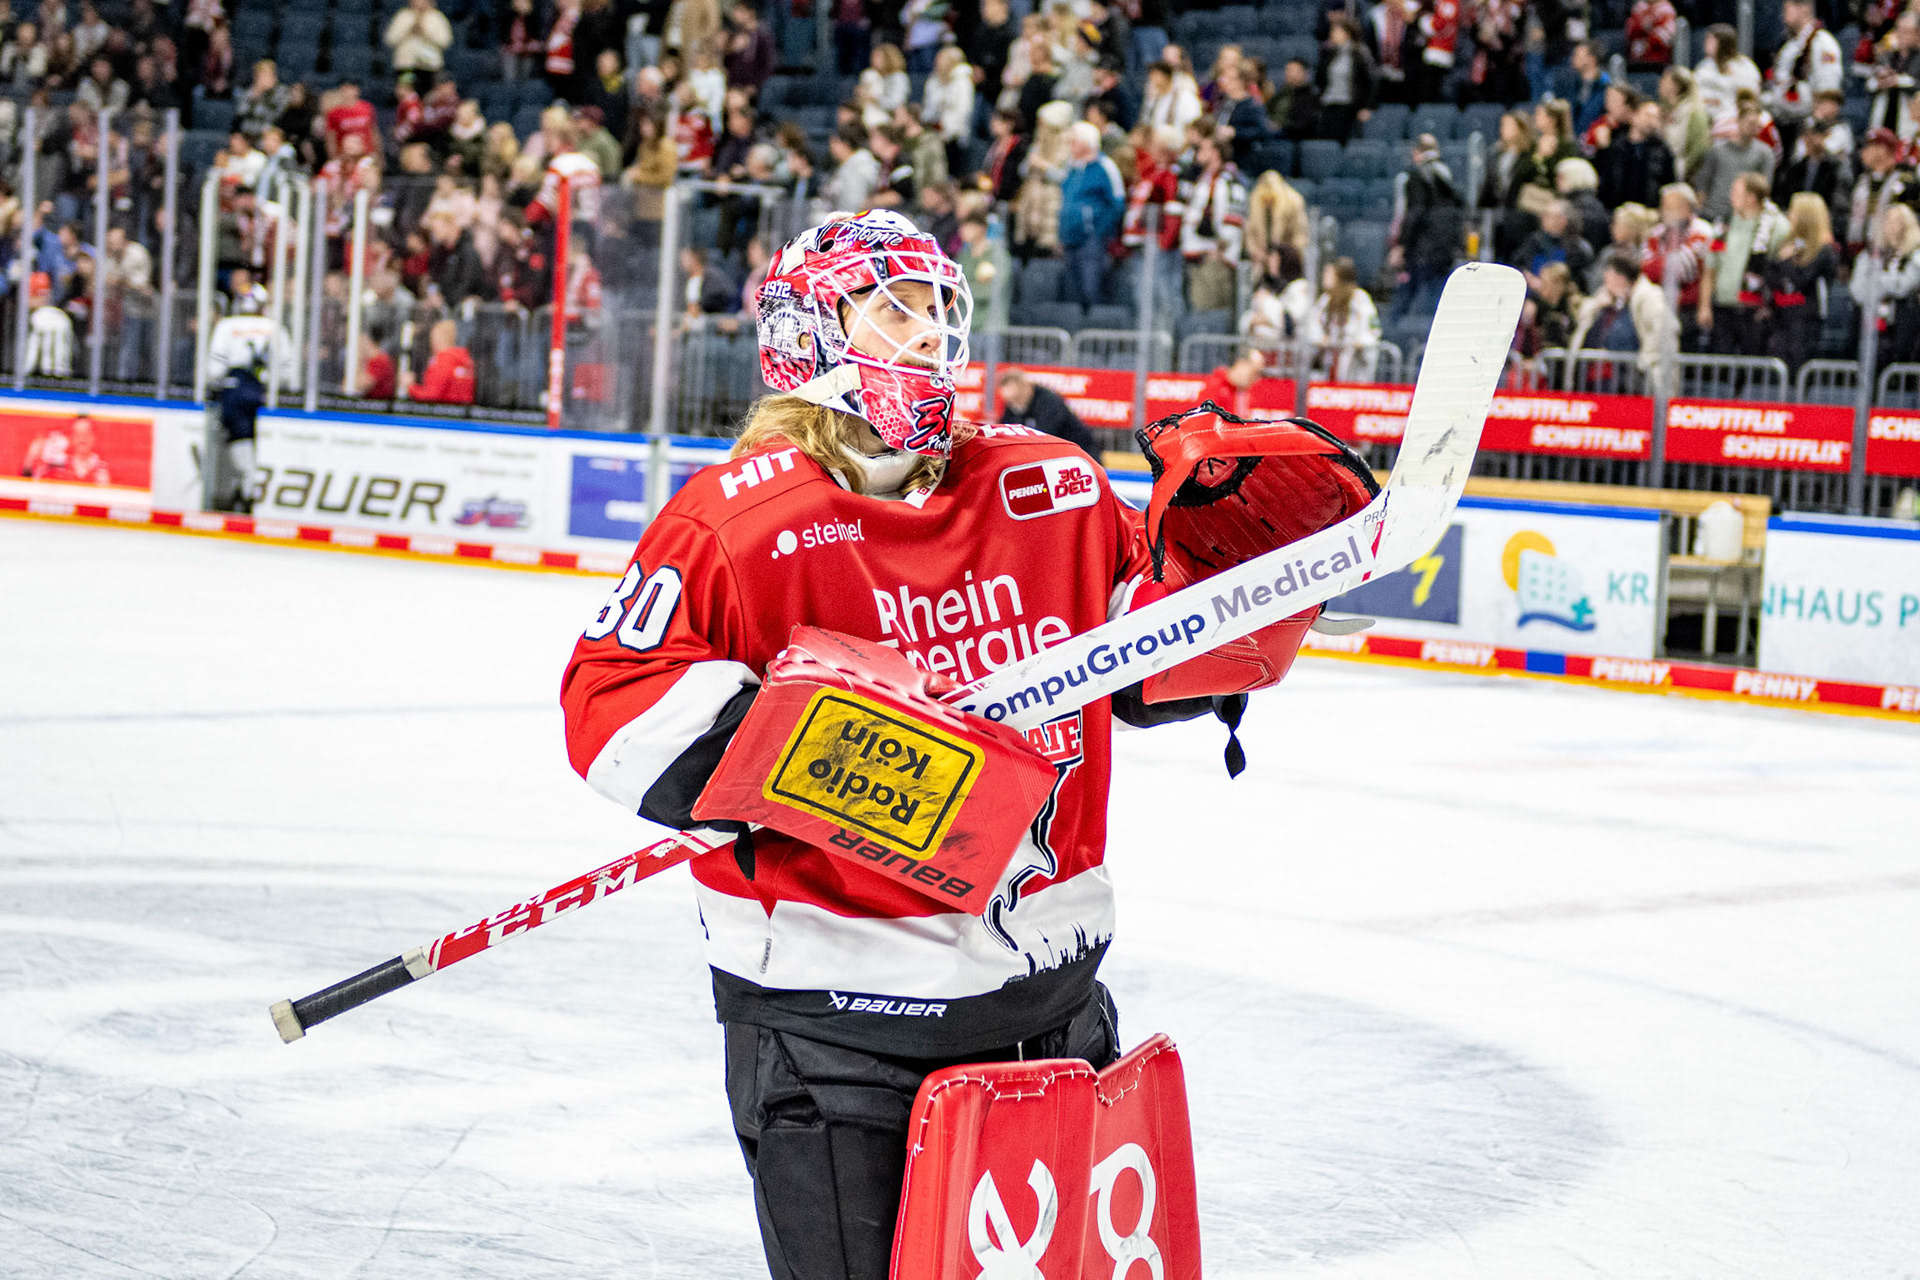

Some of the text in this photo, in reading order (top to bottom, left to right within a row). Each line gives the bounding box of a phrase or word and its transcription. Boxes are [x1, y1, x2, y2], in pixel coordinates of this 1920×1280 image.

[834, 222, 904, 249] Cologne
[763, 279, 792, 298] 1972
[719, 447, 799, 500] HIT
[801, 517, 866, 549] steinel
[872, 569, 1024, 644] Rhein
[960, 534, 1364, 724] ompuGroup Medical
[876, 615, 1072, 684] nergie
[840, 719, 932, 780] Köln
[1022, 716, 1081, 756] AIE
[807, 758, 921, 826] Radio
[485, 862, 639, 947] CCM
